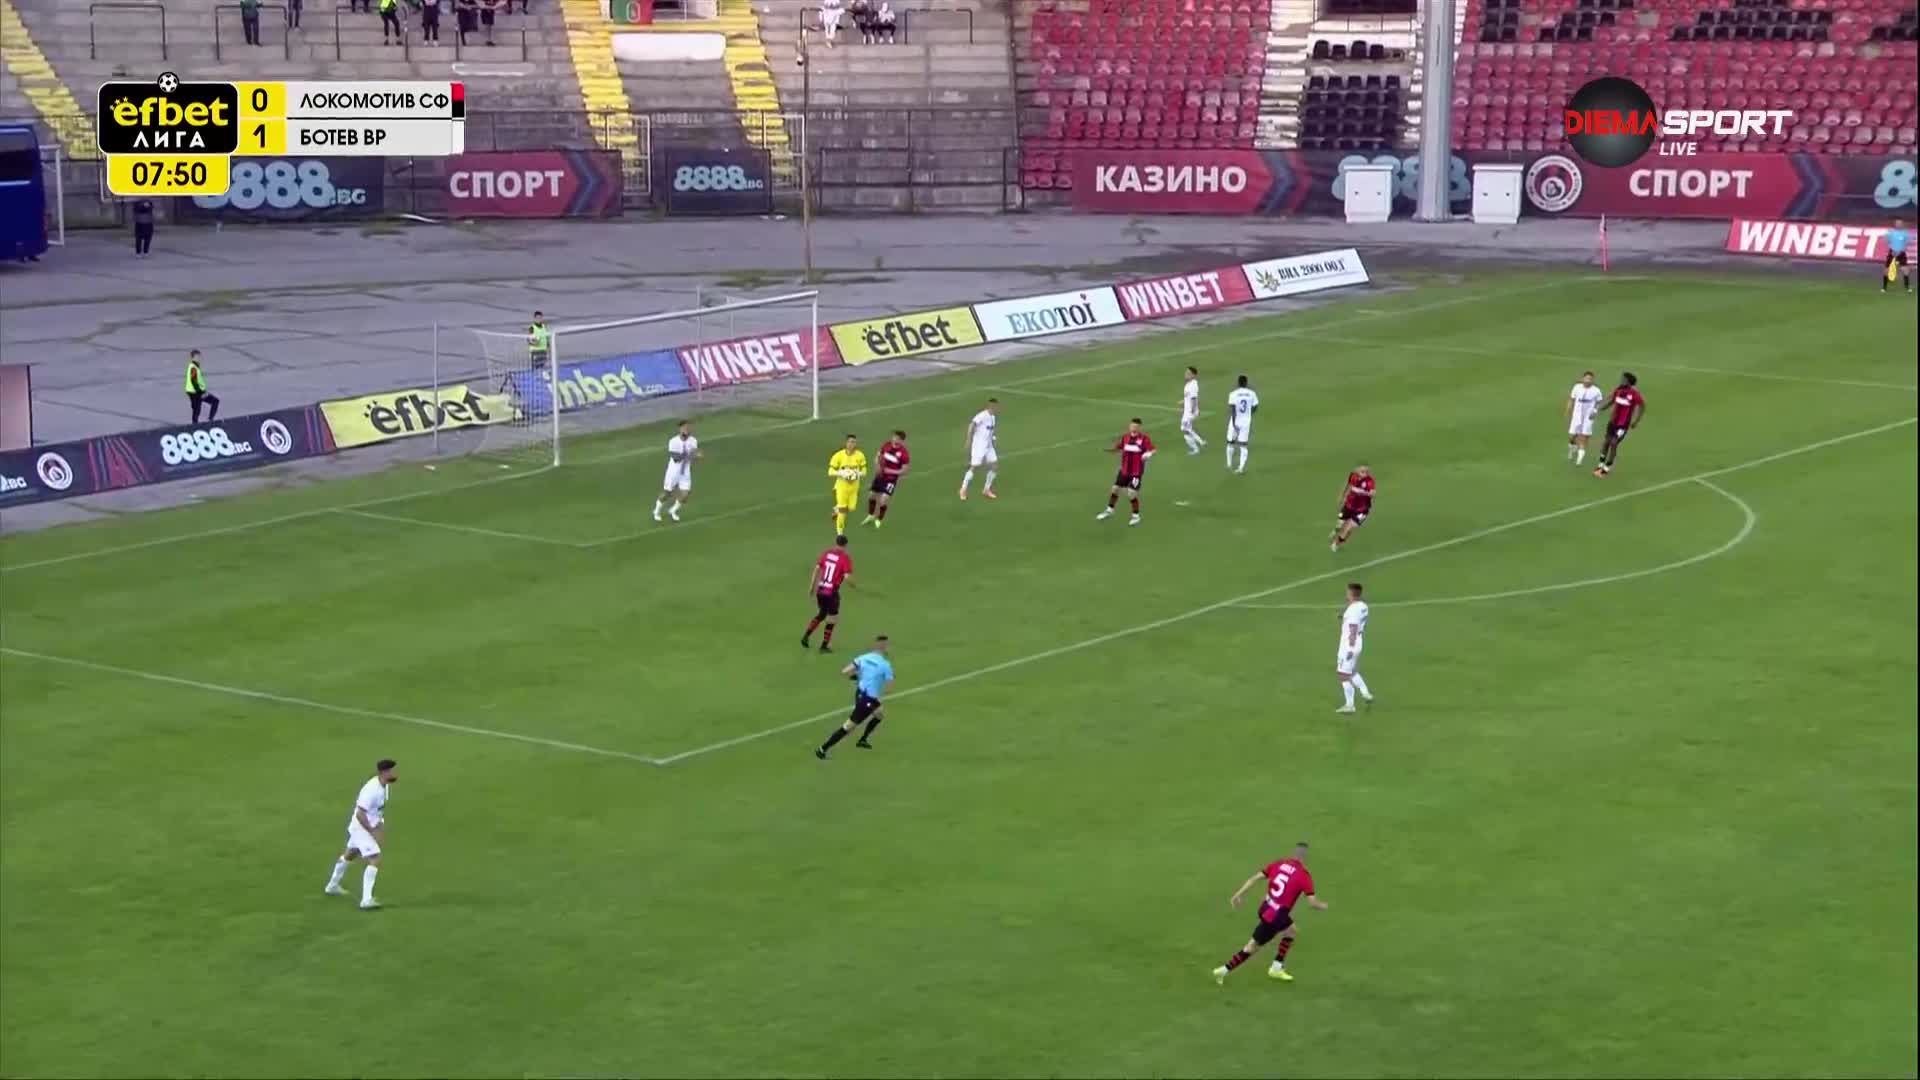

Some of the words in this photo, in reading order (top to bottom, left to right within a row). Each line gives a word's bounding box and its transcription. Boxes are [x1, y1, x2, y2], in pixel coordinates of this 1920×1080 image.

[450, 170, 565, 198] СПОРТ
[673, 165, 764, 191] 8888.BG
[1095, 165, 1247, 193] КАЗИНО
[1628, 168, 1753, 198] СПОРТ
[1739, 220, 1888, 259] WINBET
[1118, 272, 1225, 317] WINBET
[862, 315, 958, 356] efbet
[682, 333, 808, 385] WINBET
[365, 391, 490, 434] efbet
[1239, 399, 1248, 414] 3
[824, 561, 837, 583] 11
[1270, 873, 1289, 898] 5
